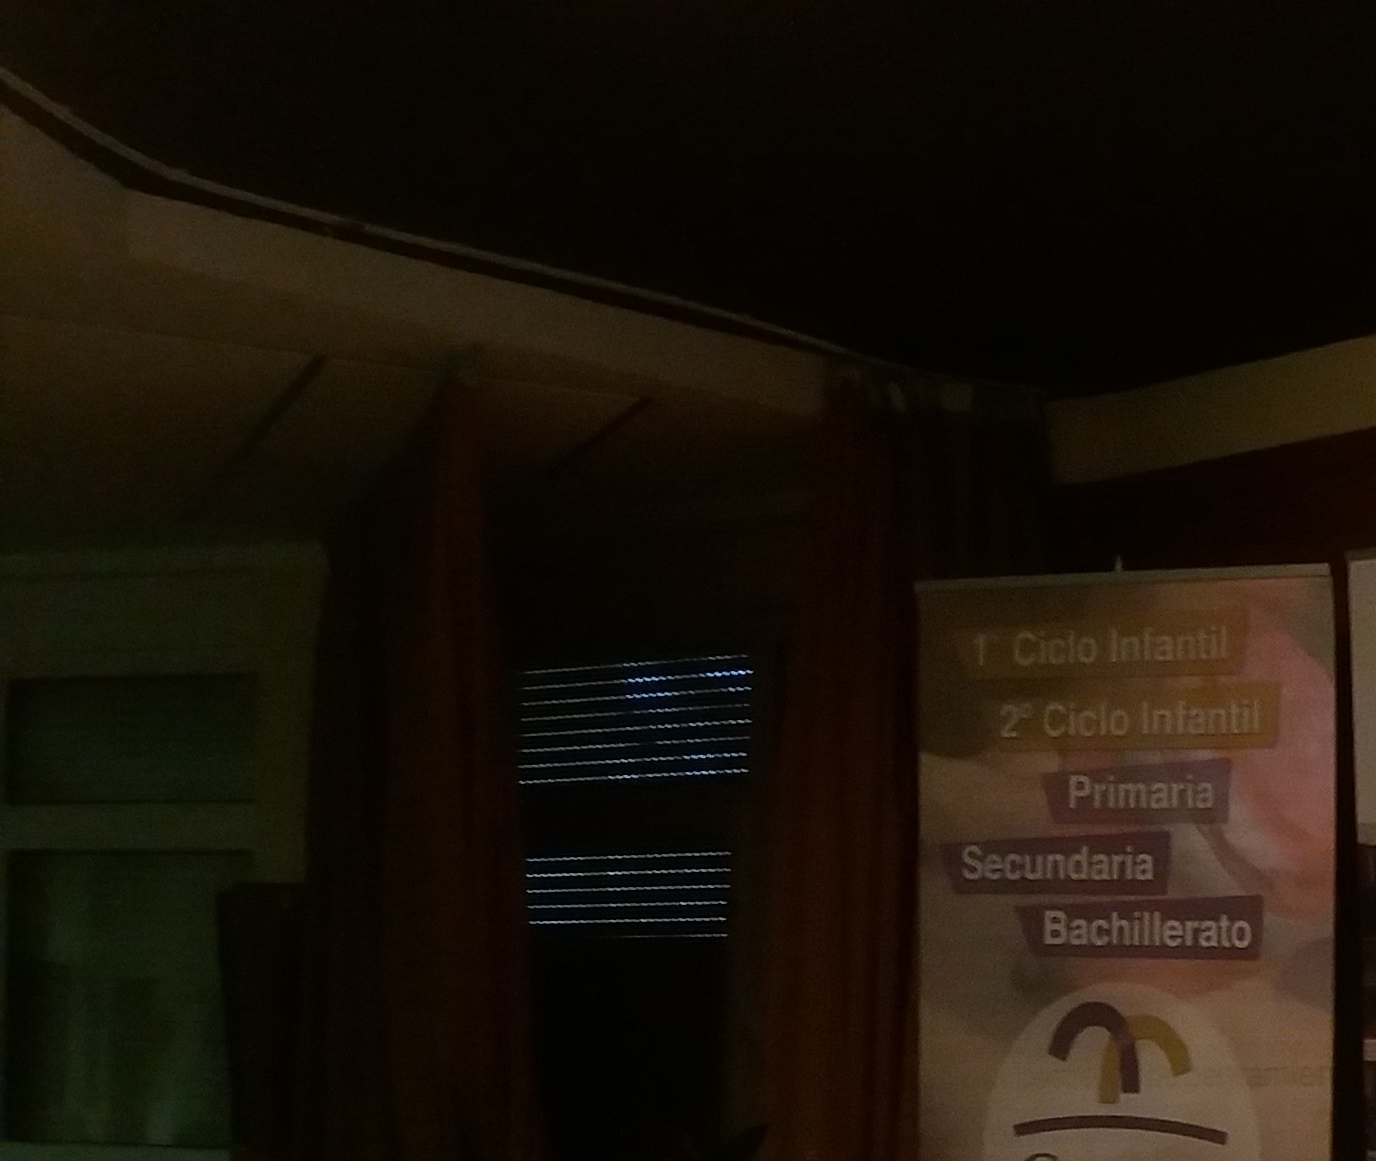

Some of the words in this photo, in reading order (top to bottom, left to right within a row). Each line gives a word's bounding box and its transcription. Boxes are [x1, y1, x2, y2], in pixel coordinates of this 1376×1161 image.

[1012, 628, 1098, 667] Ciclo
[1107, 624, 1230, 663] Infantil
[1042, 701, 1131, 740] Ciclo
[1140, 699, 1262, 737] Infantil
[1067, 773, 1215, 811] Primaria
[960, 844, 1156, 882] Secundaria
[1042, 908, 1253, 950] Bachillerato
